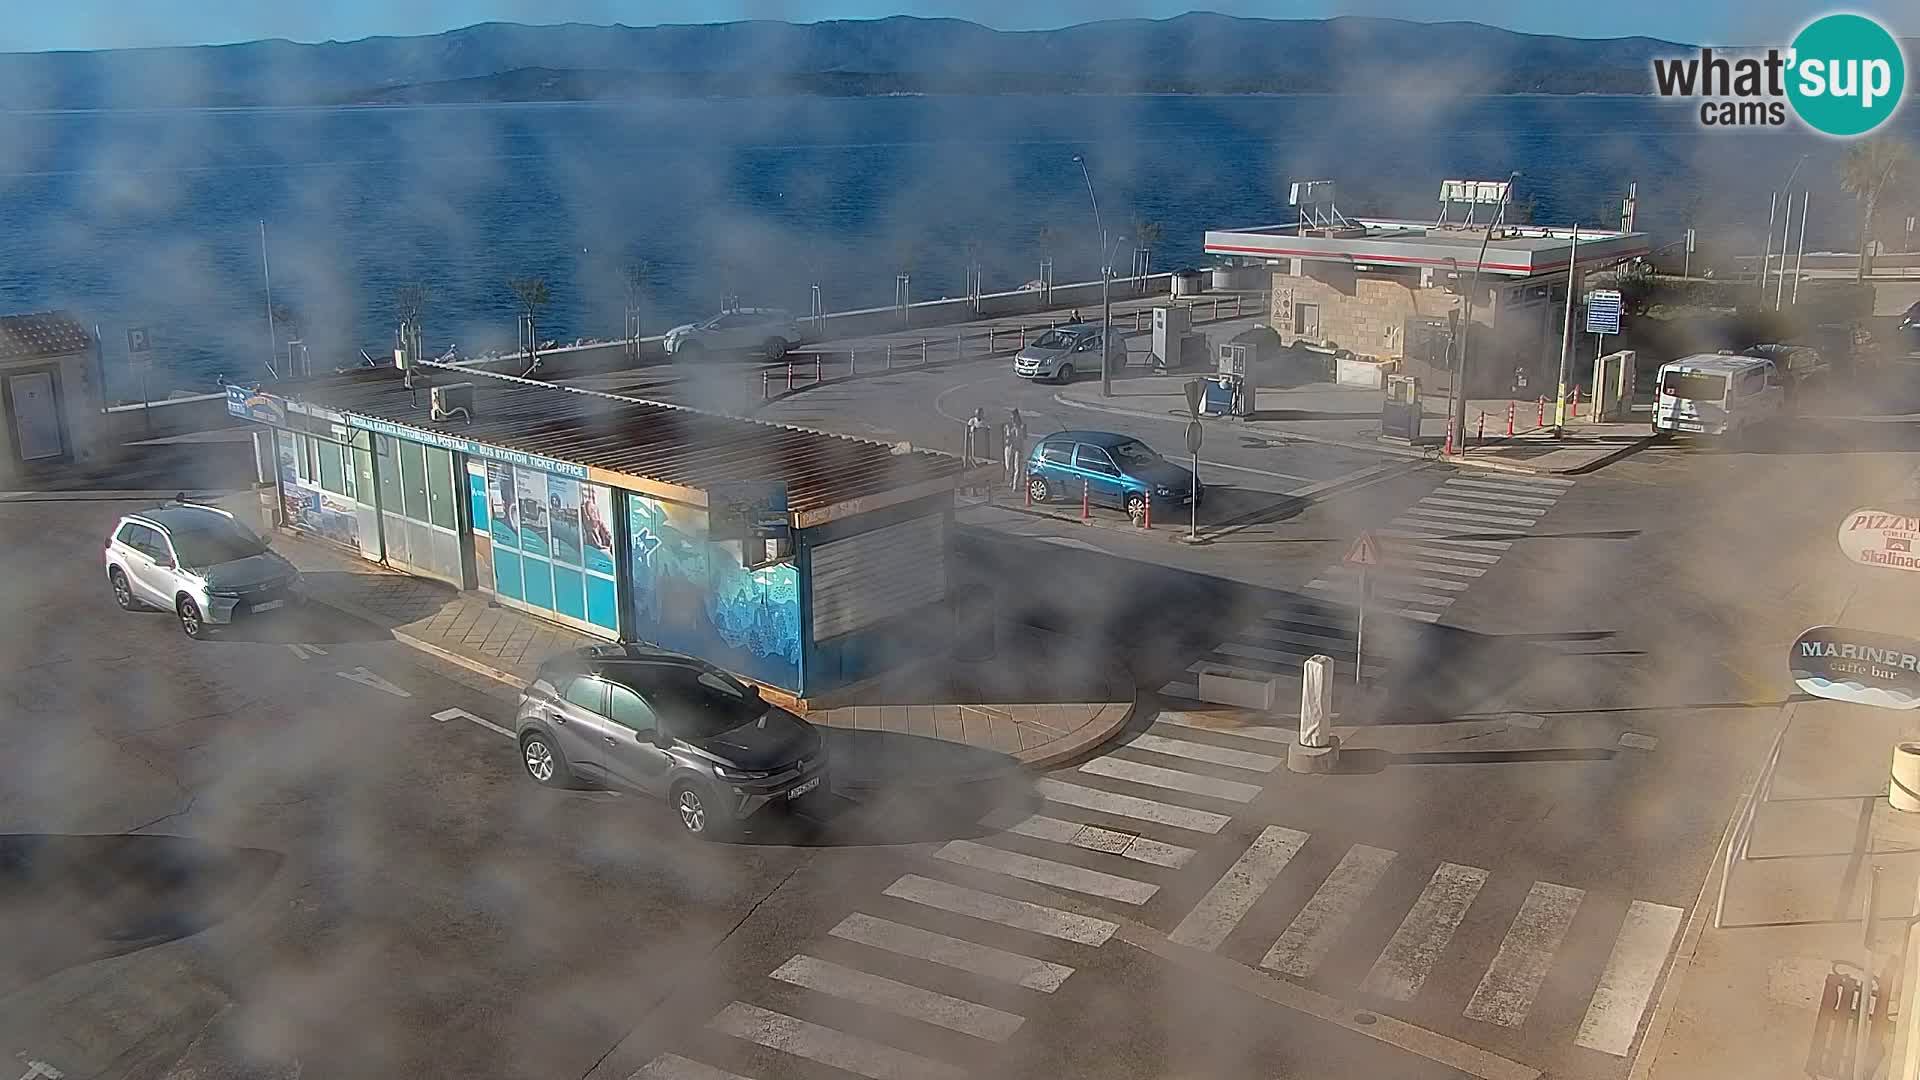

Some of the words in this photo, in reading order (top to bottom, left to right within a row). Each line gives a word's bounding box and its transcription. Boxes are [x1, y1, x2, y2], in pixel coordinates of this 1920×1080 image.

[437, 436, 469, 451] POSTAJA
[480, 446, 494, 457] BUS
[495, 449, 527, 465] STATION
[529, 456, 556, 470] TICKET
[556, 462, 584, 477] OFFICE
[1848, 514, 1920, 532] PIZZE
[1830, 660, 1867, 675] caffe
[1871, 665, 1897, 680] bar
